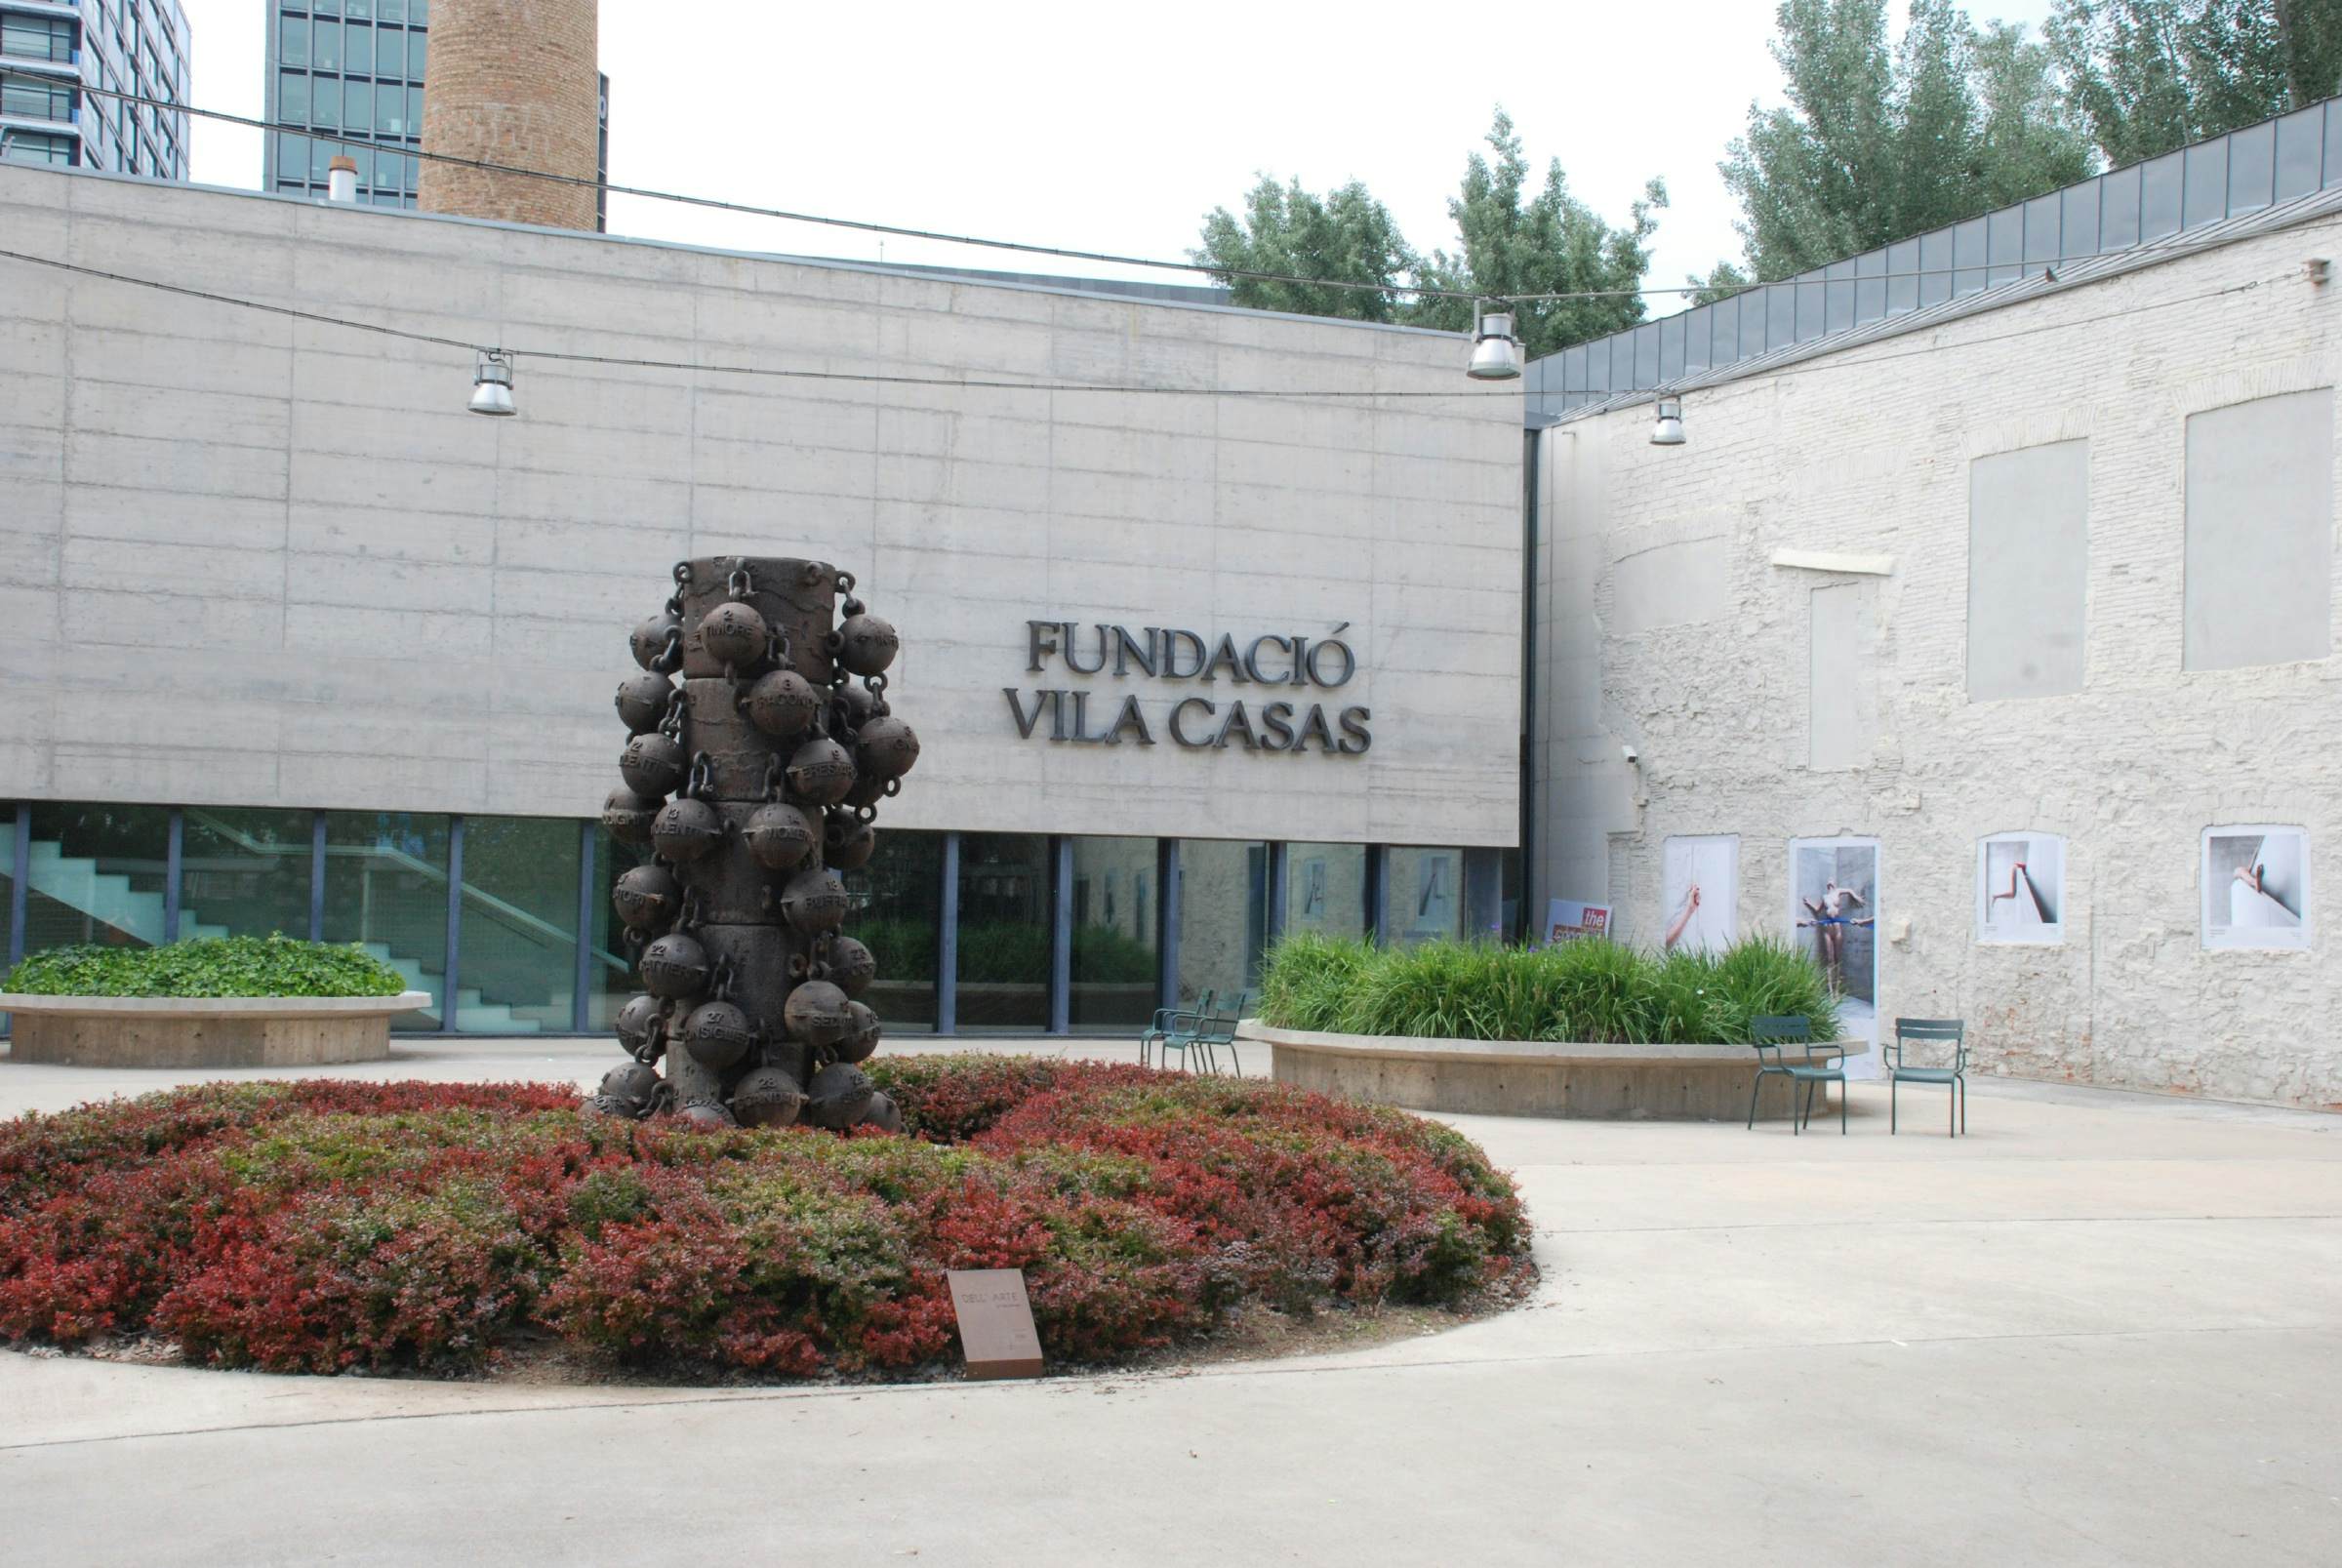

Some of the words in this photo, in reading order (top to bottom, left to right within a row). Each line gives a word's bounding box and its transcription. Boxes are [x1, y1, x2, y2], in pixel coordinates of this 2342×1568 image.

[1026, 620, 1355, 689] FUNDACIÓ
[1002, 687, 1157, 745] VILA
[1168, 697, 1372, 754] CASAS
[1585, 909, 1604, 926] the
